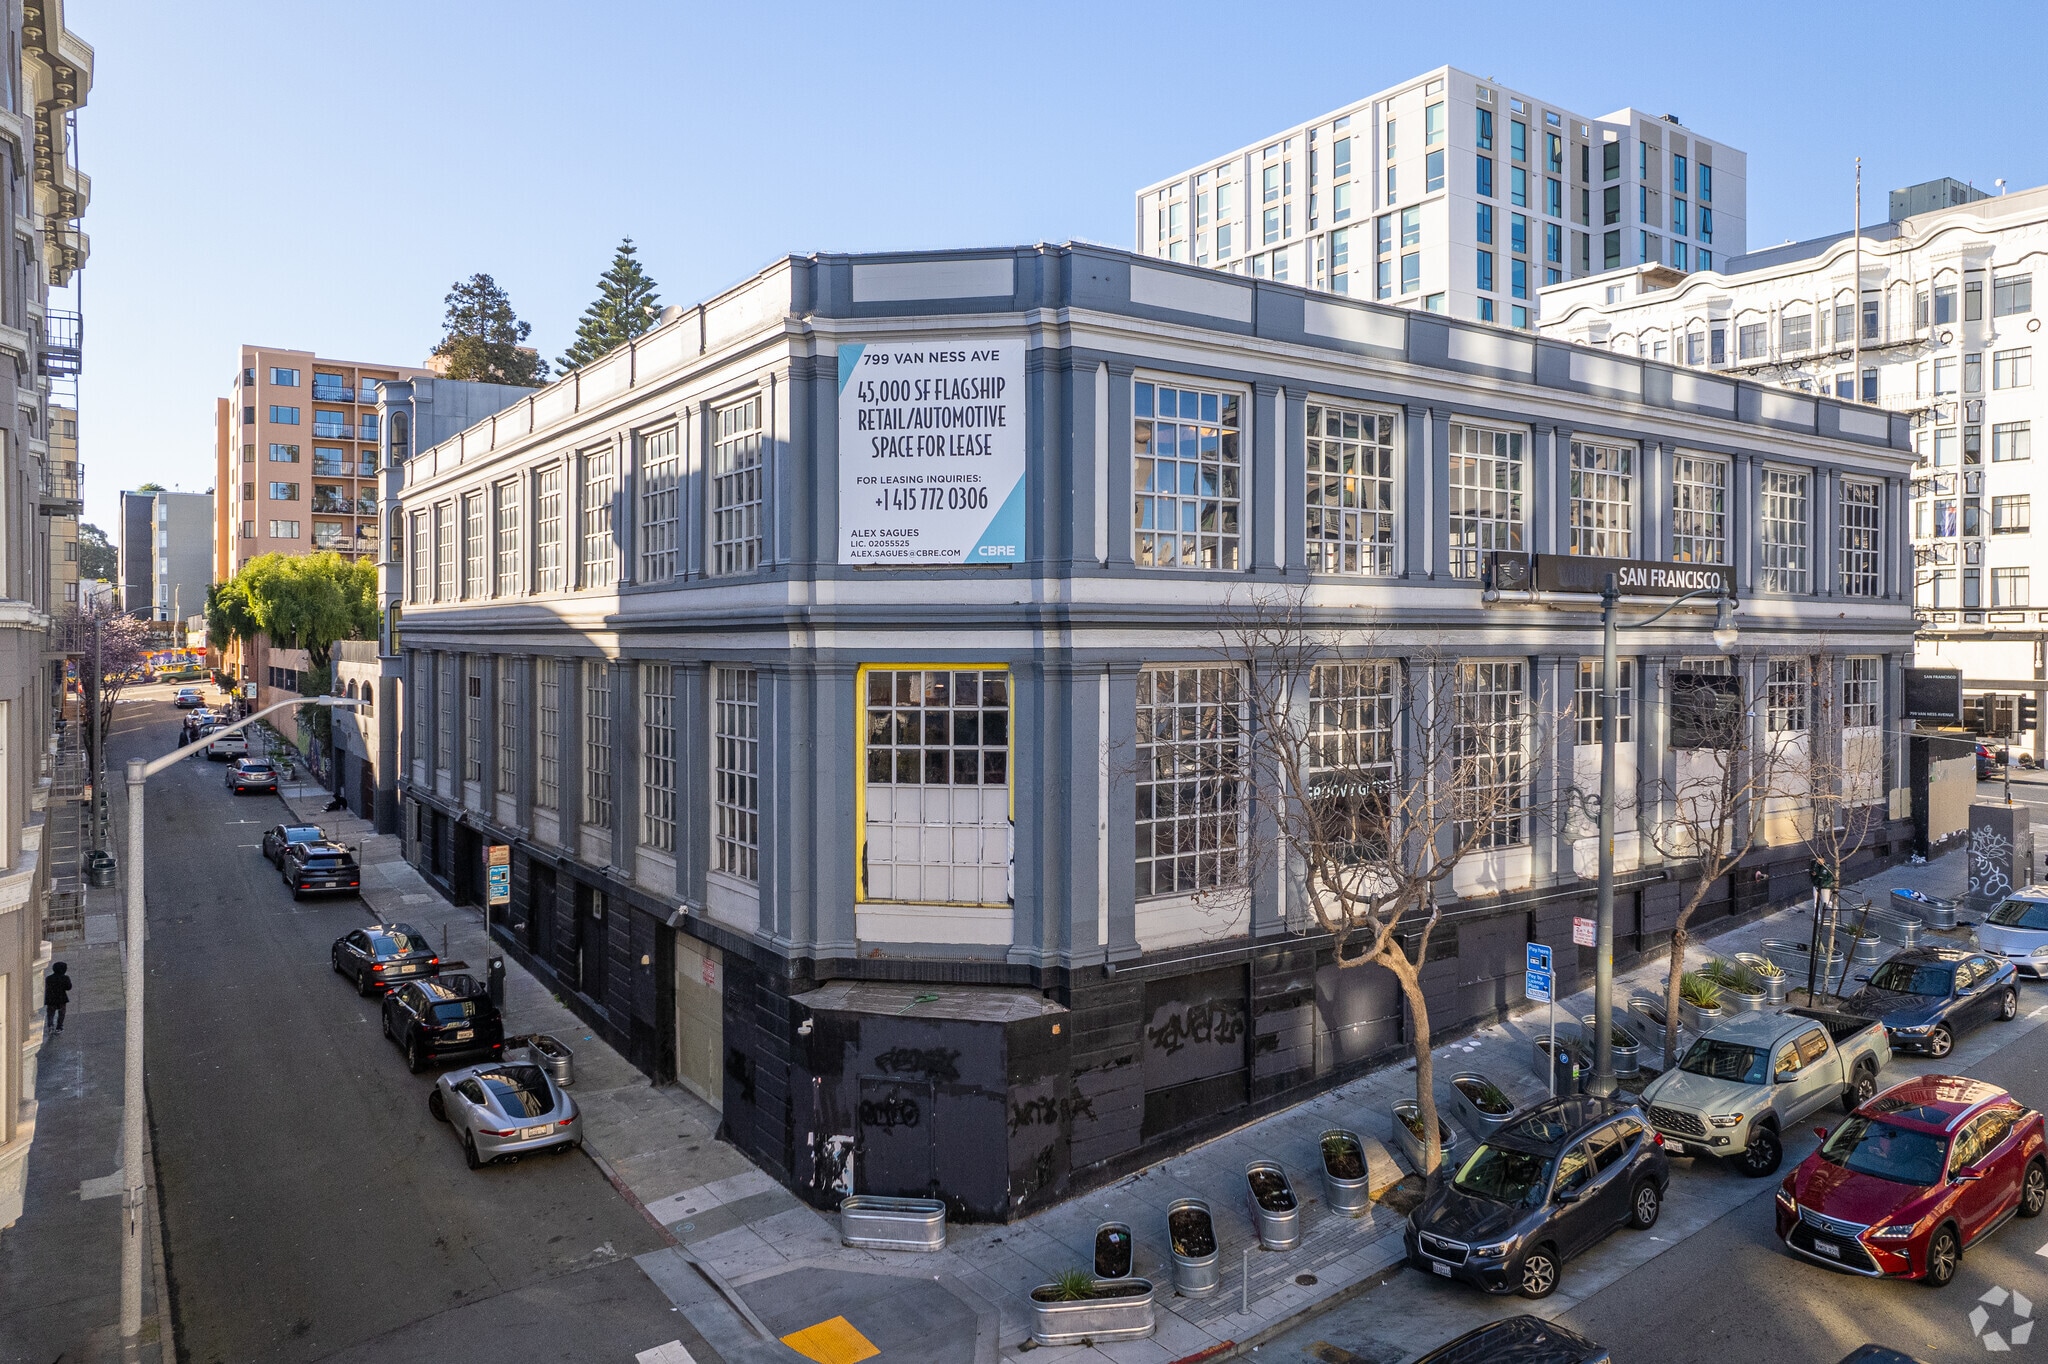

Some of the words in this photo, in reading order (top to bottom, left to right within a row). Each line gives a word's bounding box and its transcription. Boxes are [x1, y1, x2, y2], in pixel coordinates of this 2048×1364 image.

[864, 354, 889, 365] 799
[894, 353, 924, 364] VAN
[929, 351, 966, 363] NESS
[970, 350, 1000, 362] AVE
[858, 380, 911, 406] 45,000
[914, 379, 932, 401] SF
[934, 377, 1006, 401] FLAGSHIP
[858, 405, 1007, 430] RETAIL/AUTOMOTIVE
[871, 436, 914, 458] SPACE
[916, 434, 946, 458] FOR
[949, 434, 992, 457] LEASE
[856, 477, 877, 485] FOR
[880, 475, 924, 484] LEASING
[926, 474, 982, 483] INQUIRIES:
[875, 488, 889, 511] +1
[893, 488, 917, 511] 415
[920, 487, 944, 511] 772
[948, 486, 988, 510] 0306
[851, 530, 877, 538] ALEX
[879, 528, 920, 537] SAGUES
[850, 549, 961, 558] ALEX.SAGUES@CBRE.COM
[978, 545, 1016, 556] CBRE
[1619, 566, 1648, 587] SAN
[1650, 568, 1721, 589] FRANCISCO
